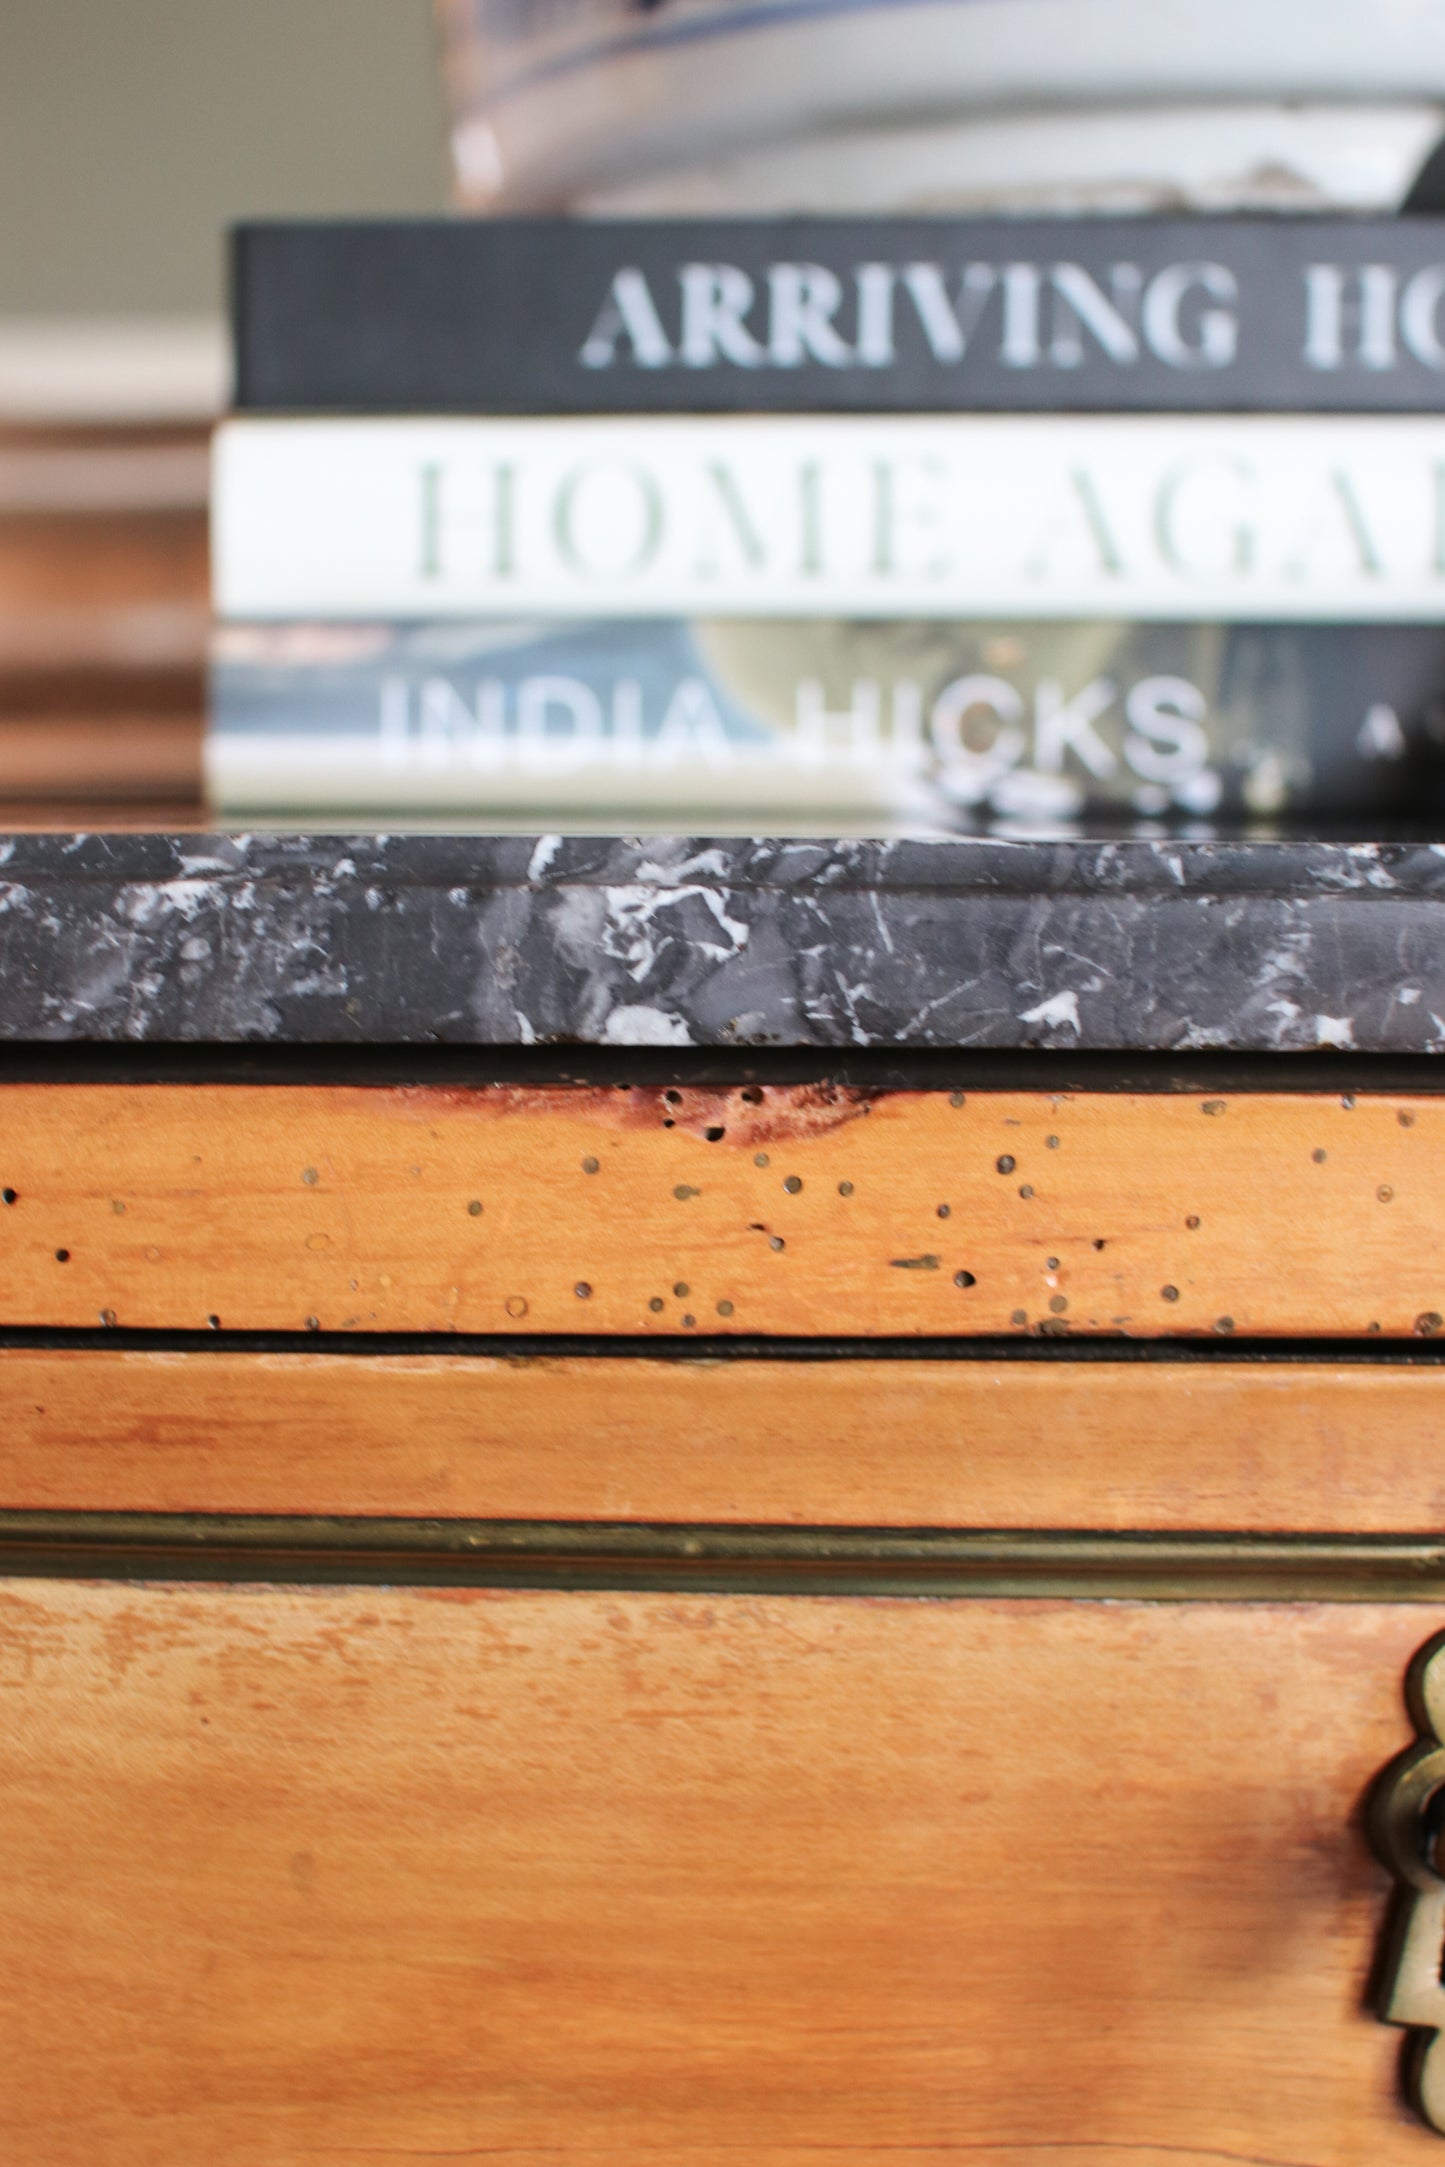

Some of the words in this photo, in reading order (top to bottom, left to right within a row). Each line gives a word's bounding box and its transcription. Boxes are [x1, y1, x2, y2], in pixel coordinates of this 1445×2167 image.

[580, 262, 1238, 368] ARRIVING
[417, 458, 950, 581] HOME
[378, 675, 730, 776] INDIA
[795, 674, 1209, 785] HICKS
